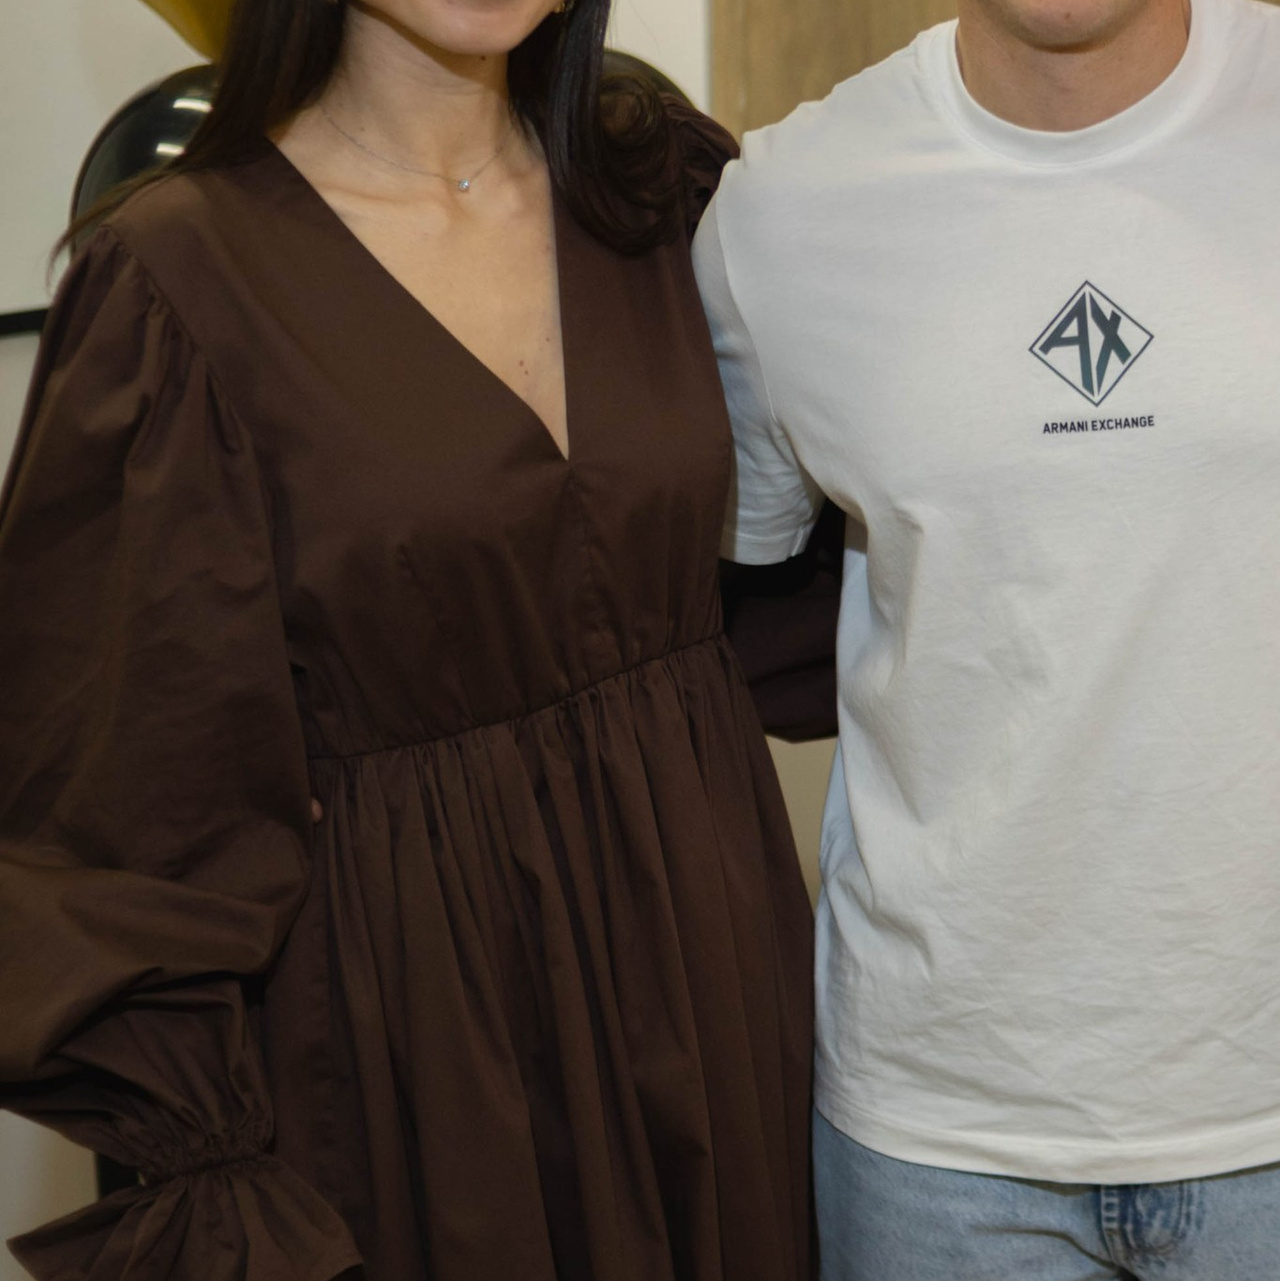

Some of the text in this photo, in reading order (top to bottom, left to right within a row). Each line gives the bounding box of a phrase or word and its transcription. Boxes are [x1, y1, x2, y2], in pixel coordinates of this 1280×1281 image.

[1038, 291, 1132, 398] AX
[1043, 415, 1155, 434] ARMANI EXCHANGE
